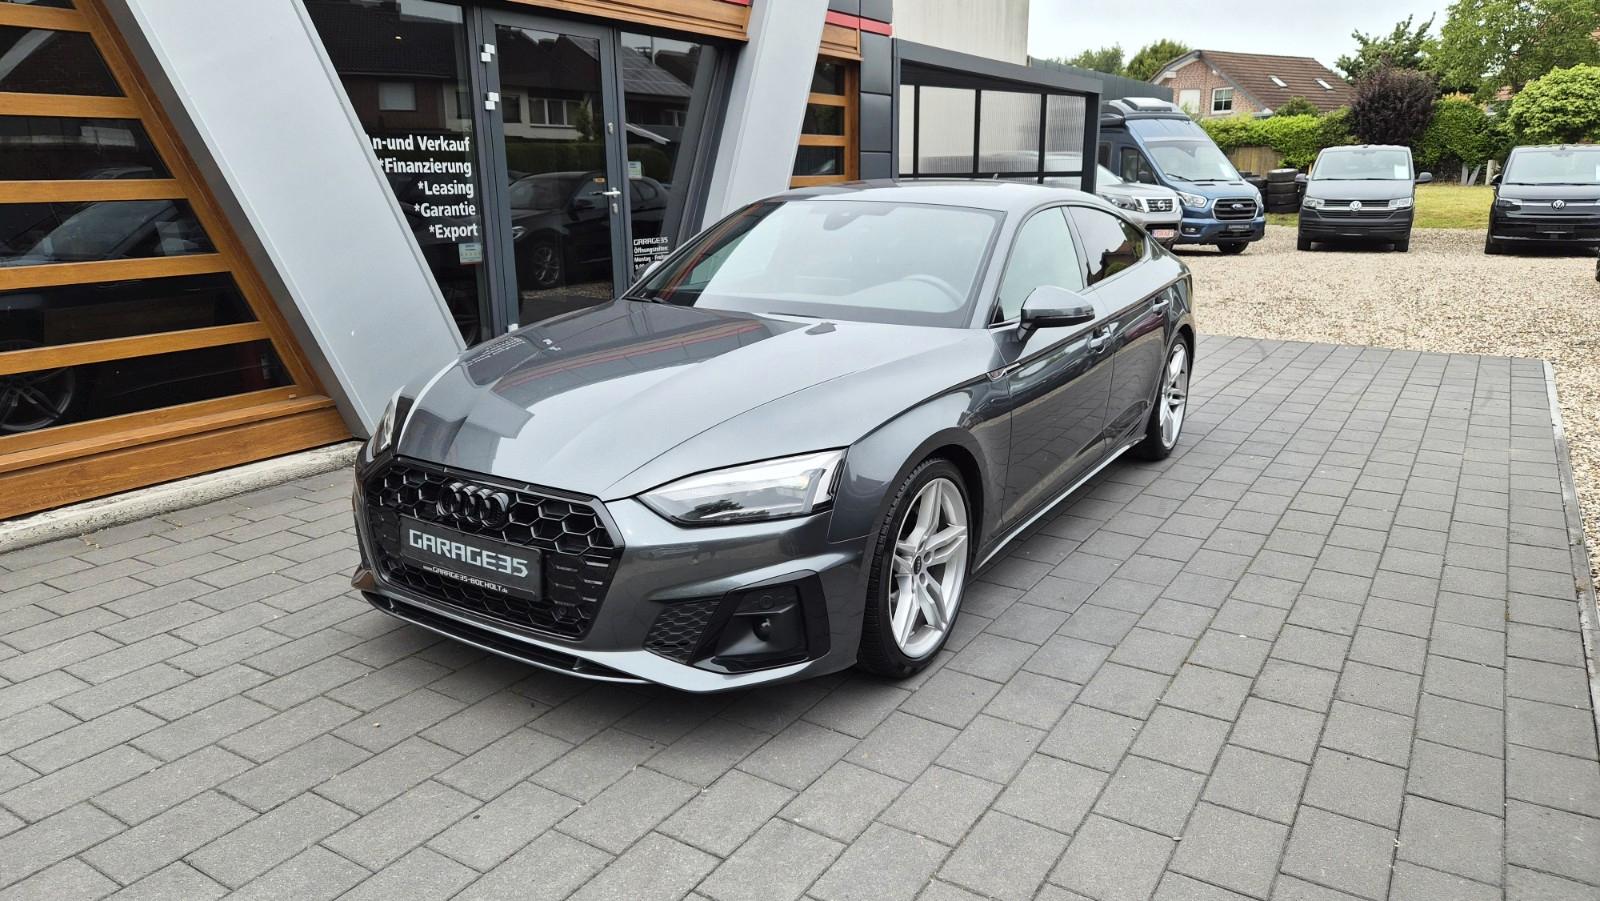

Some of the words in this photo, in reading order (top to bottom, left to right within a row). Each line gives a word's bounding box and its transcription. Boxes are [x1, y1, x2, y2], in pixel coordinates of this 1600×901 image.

[371, 134, 414, 150] n-und
[417, 135, 470, 151] Verkauf
[633, 237, 668, 246] GARAGE35
[409, 529, 528, 578] GARAGE35
